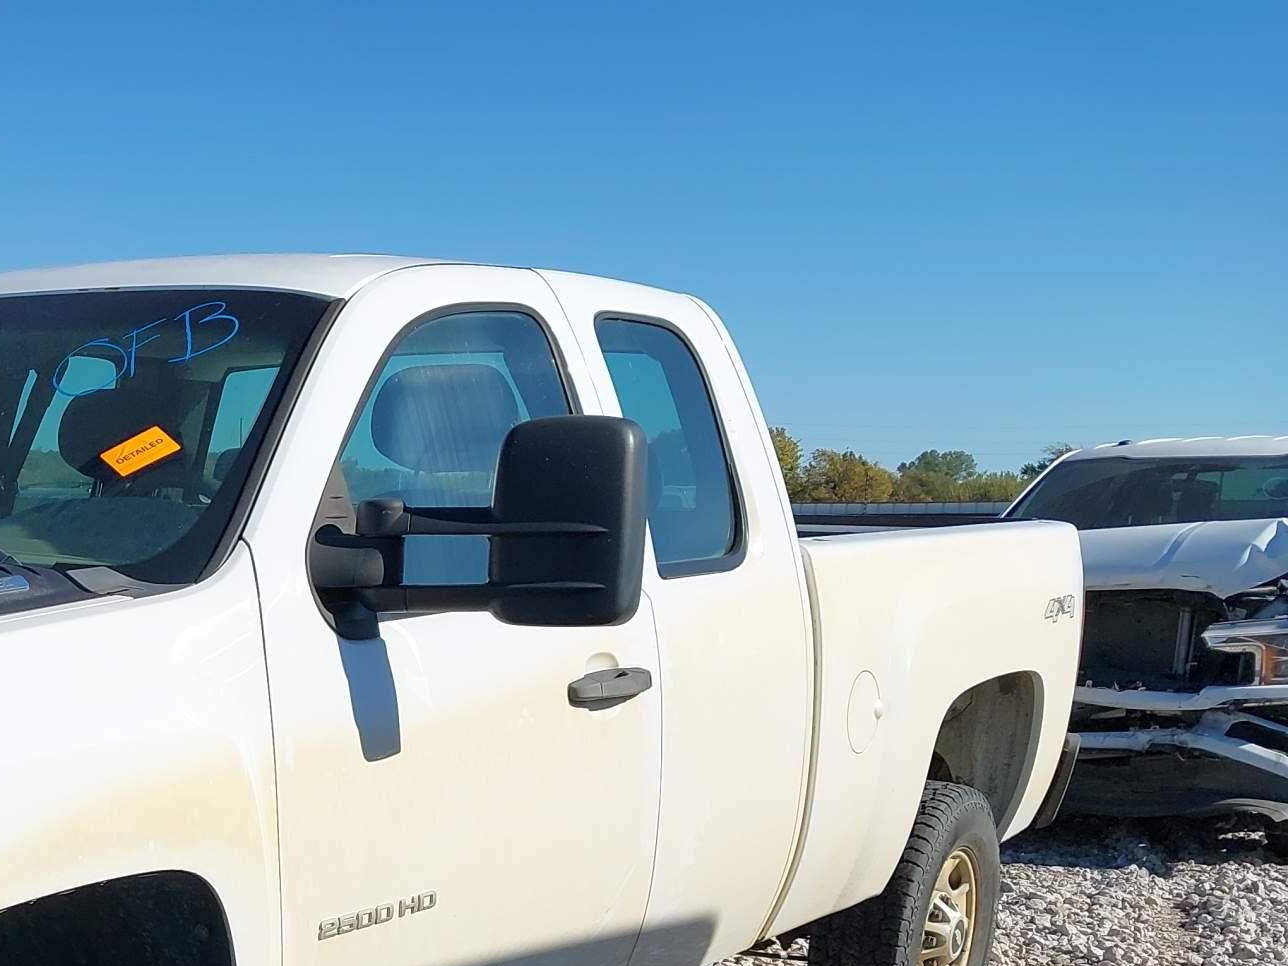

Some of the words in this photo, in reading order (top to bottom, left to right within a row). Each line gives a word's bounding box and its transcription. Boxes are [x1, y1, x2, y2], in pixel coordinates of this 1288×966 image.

[115, 437, 164, 465] DETAILED
[317, 902, 394, 941] 2500
[398, 890, 437, 918] HD
